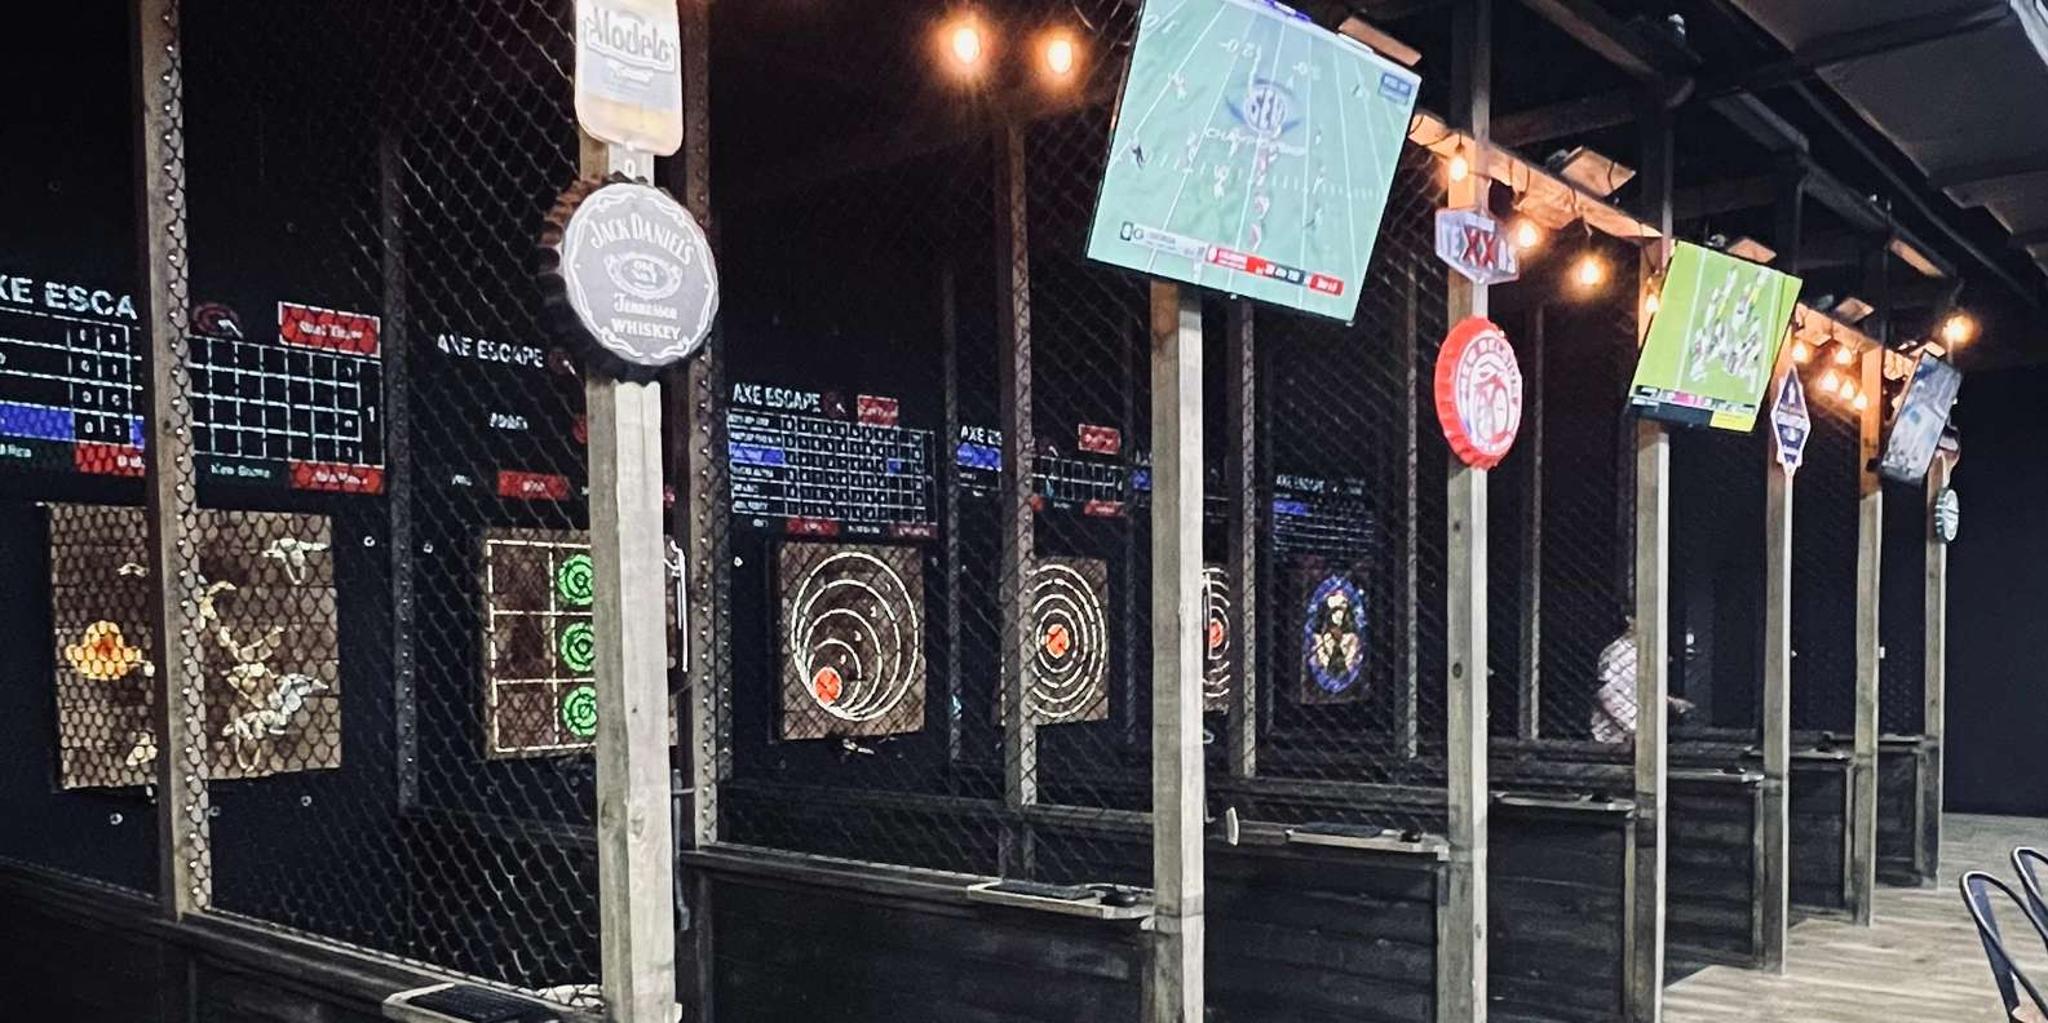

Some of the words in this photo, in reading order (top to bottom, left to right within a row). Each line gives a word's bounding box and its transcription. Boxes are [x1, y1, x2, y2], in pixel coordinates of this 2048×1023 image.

[590, 217, 629, 249] JACK
[611, 318, 682, 341] WHISKEY
[733, 383, 762, 406] AXE
[765, 388, 821, 413] ESCAPE
[961, 424, 984, 443] AXE
